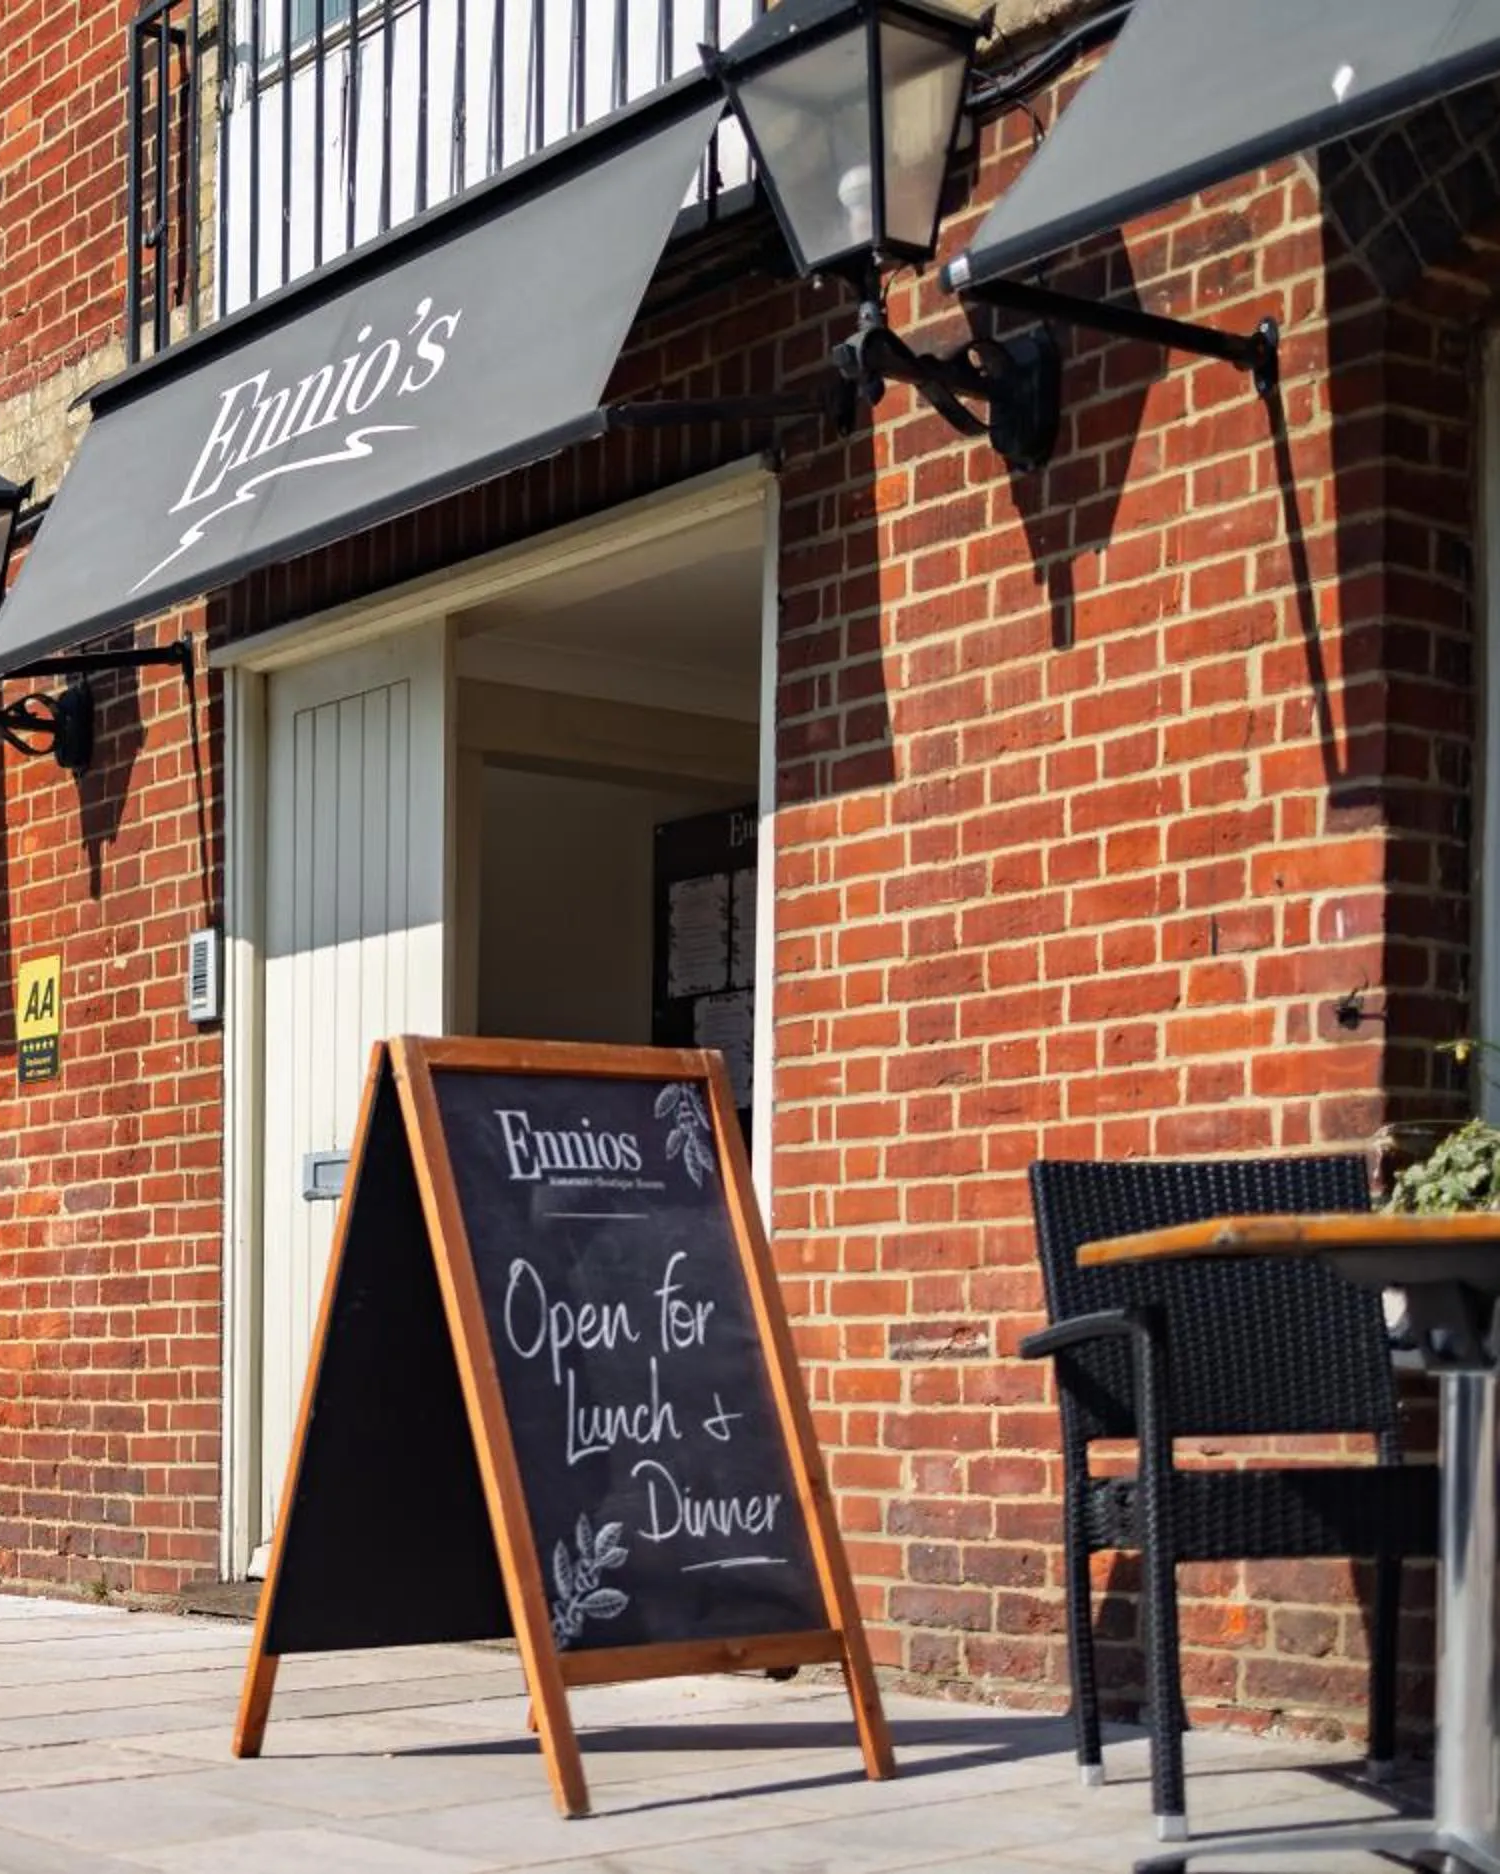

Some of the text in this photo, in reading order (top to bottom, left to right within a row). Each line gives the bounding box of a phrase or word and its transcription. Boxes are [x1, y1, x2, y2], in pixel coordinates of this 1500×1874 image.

[168, 297, 462, 514] Ennio's
[23, 976, 55, 1023] AA
[495, 1109, 642, 1181] Ennios
[504, 1251, 714, 1385] Open for
[567, 1357, 682, 1465] Lunch
[631, 1459, 781, 1543] Dinner
